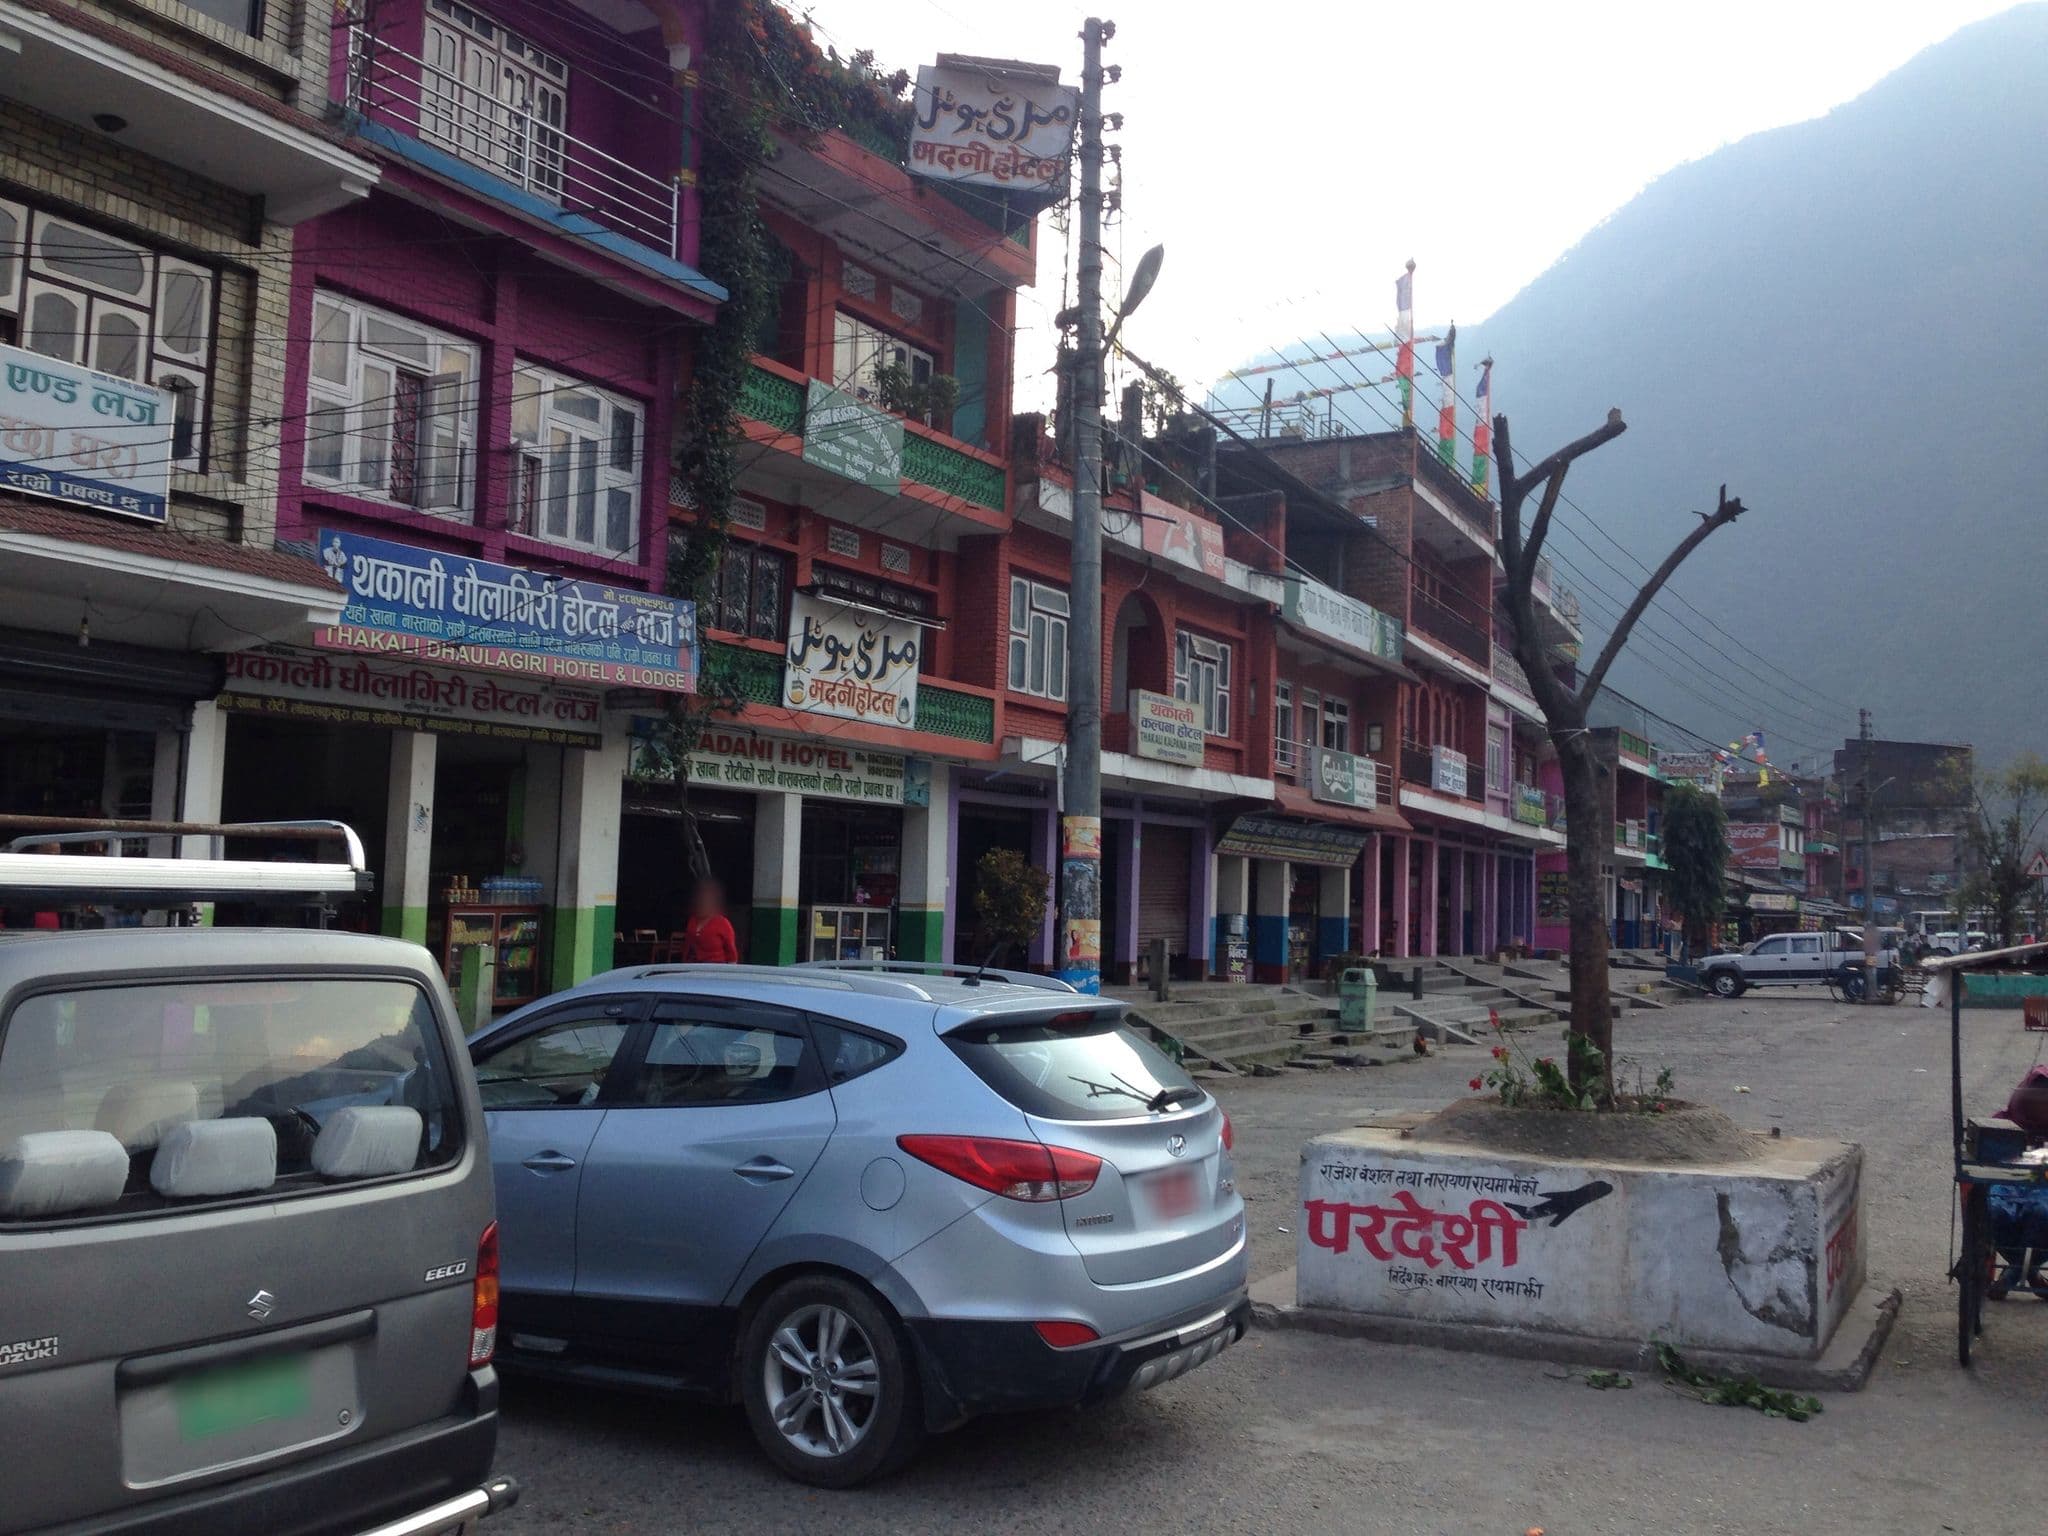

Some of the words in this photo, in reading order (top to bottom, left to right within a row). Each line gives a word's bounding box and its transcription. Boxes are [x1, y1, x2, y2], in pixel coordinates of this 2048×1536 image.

[6, 363, 82, 404] एण्ड
[92, 385, 160, 427] लज
[351, 555, 447, 611] थकाली
[452, 562, 559, 631] धौलागिरी
[562, 585, 620, 639] होटल
[636, 607, 675, 647] लज
[327, 625, 419, 655] THAKALI
[427, 639, 546, 674] DHAULAGIRI
[553, 658, 610, 681] HOTEL
[615, 666, 626, 682] &
[632, 669, 685, 689] LODGE
[225, 652, 332, 690] थकाली
[471, 680, 543, 717] होटल
[553, 696, 601, 722] लज
[1140, 717, 1176, 734] कल्पना
[1177, 723, 1203, 741] होटल
[1151, 702, 1194, 725] थकाली
[693, 733, 774, 762] ADANI
[780, 742, 854, 774] HOTEL
[1320, 1161, 1358, 1183] राजेश
[1396, 1170, 1423, 1188] तथा
[1423, 1172, 1472, 1192] नारायण
[1304, 1190, 1528, 1270] परदेशी
[425, 1262, 466, 1281] EECO
[1435, 1274, 1478, 1294] नारायण
[0, 1337, 58, 1355] ARUTI
[0, 1346, 58, 1365] UZUKI
